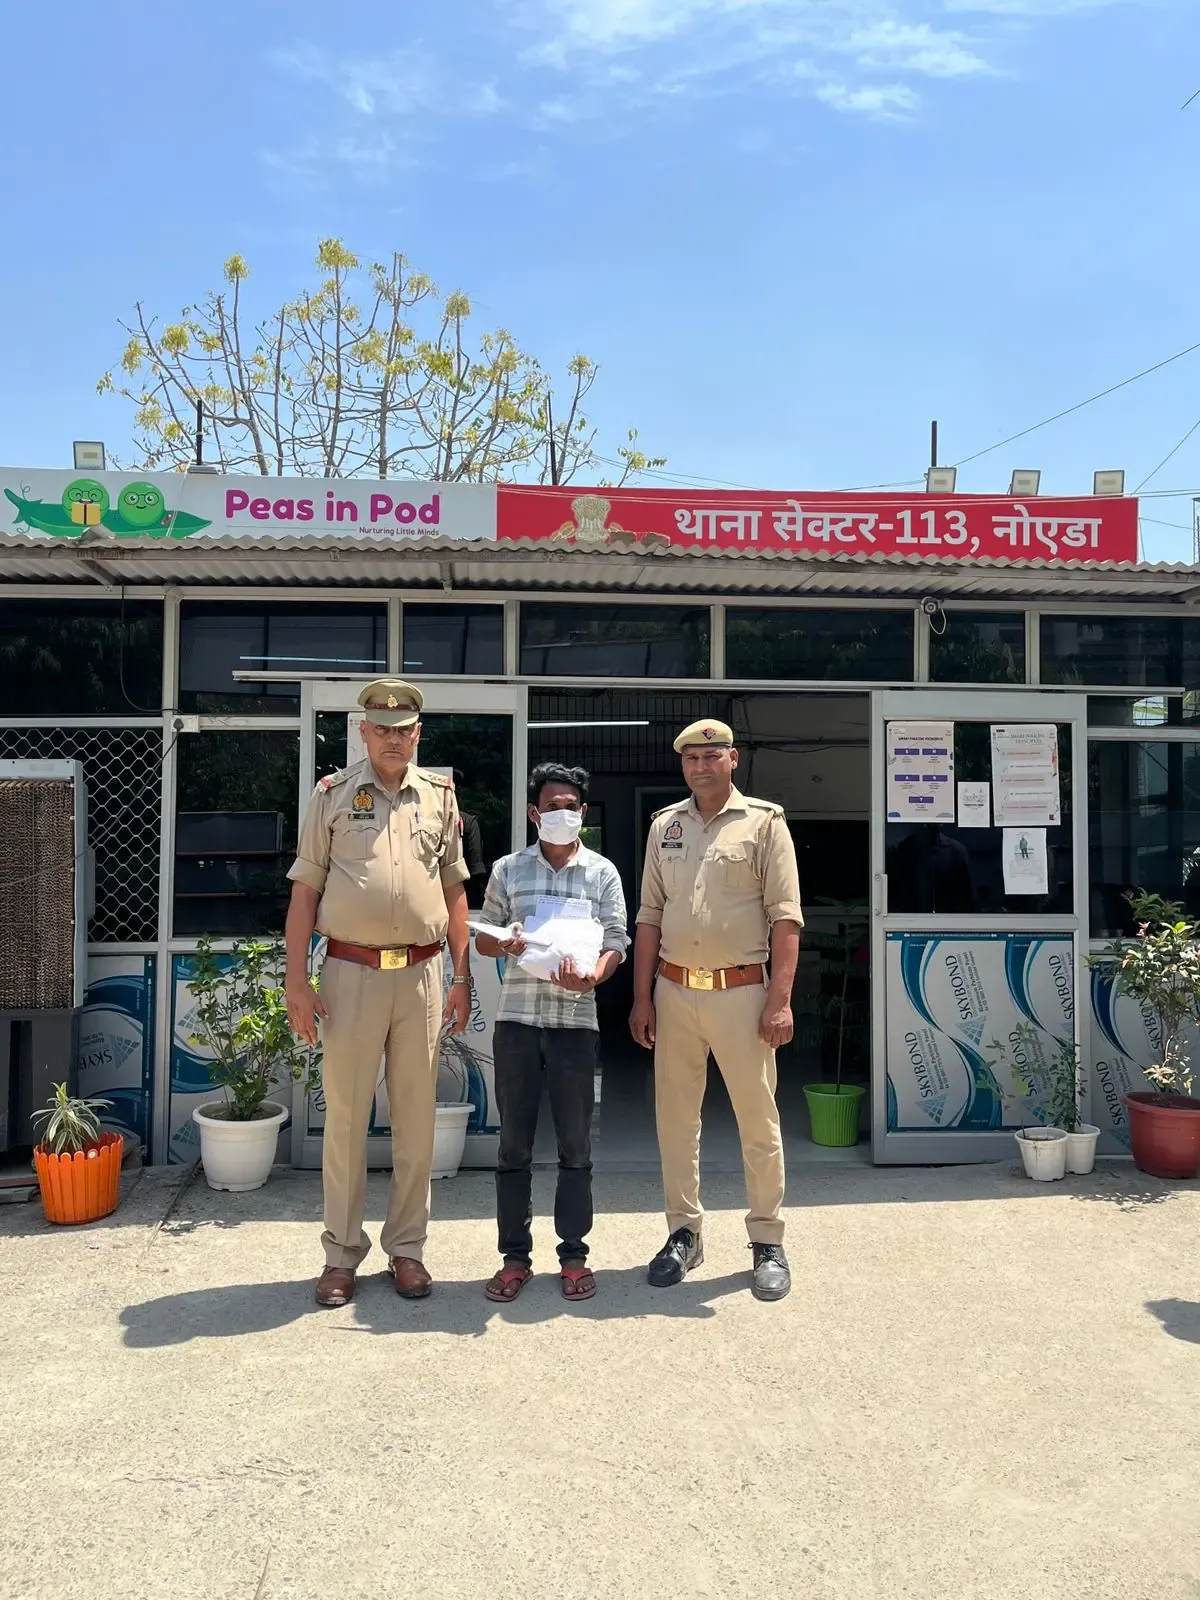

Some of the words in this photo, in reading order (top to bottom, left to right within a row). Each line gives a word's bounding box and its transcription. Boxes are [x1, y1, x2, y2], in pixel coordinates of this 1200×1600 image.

[226, 490, 315, 520] Peas
[326, 491, 358, 521] in
[370, 494, 440, 524] Pod
[359, 526, 395, 536] Nurturing
[396, 527, 416, 536] Little
[417, 528, 440, 536] Minds
[674, 508, 763, 540] थाना
[771, 499, 980, 553] सेक्टर-113,
[991, 504, 1103, 555] नोएडा
[944, 955, 973, 1020] SKYBOND
[1048, 954, 1074, 1020] SKYBOND
[904, 1031, 933, 1098] SKYBOND
[1095, 1061, 1125, 1126] SKYBOND
